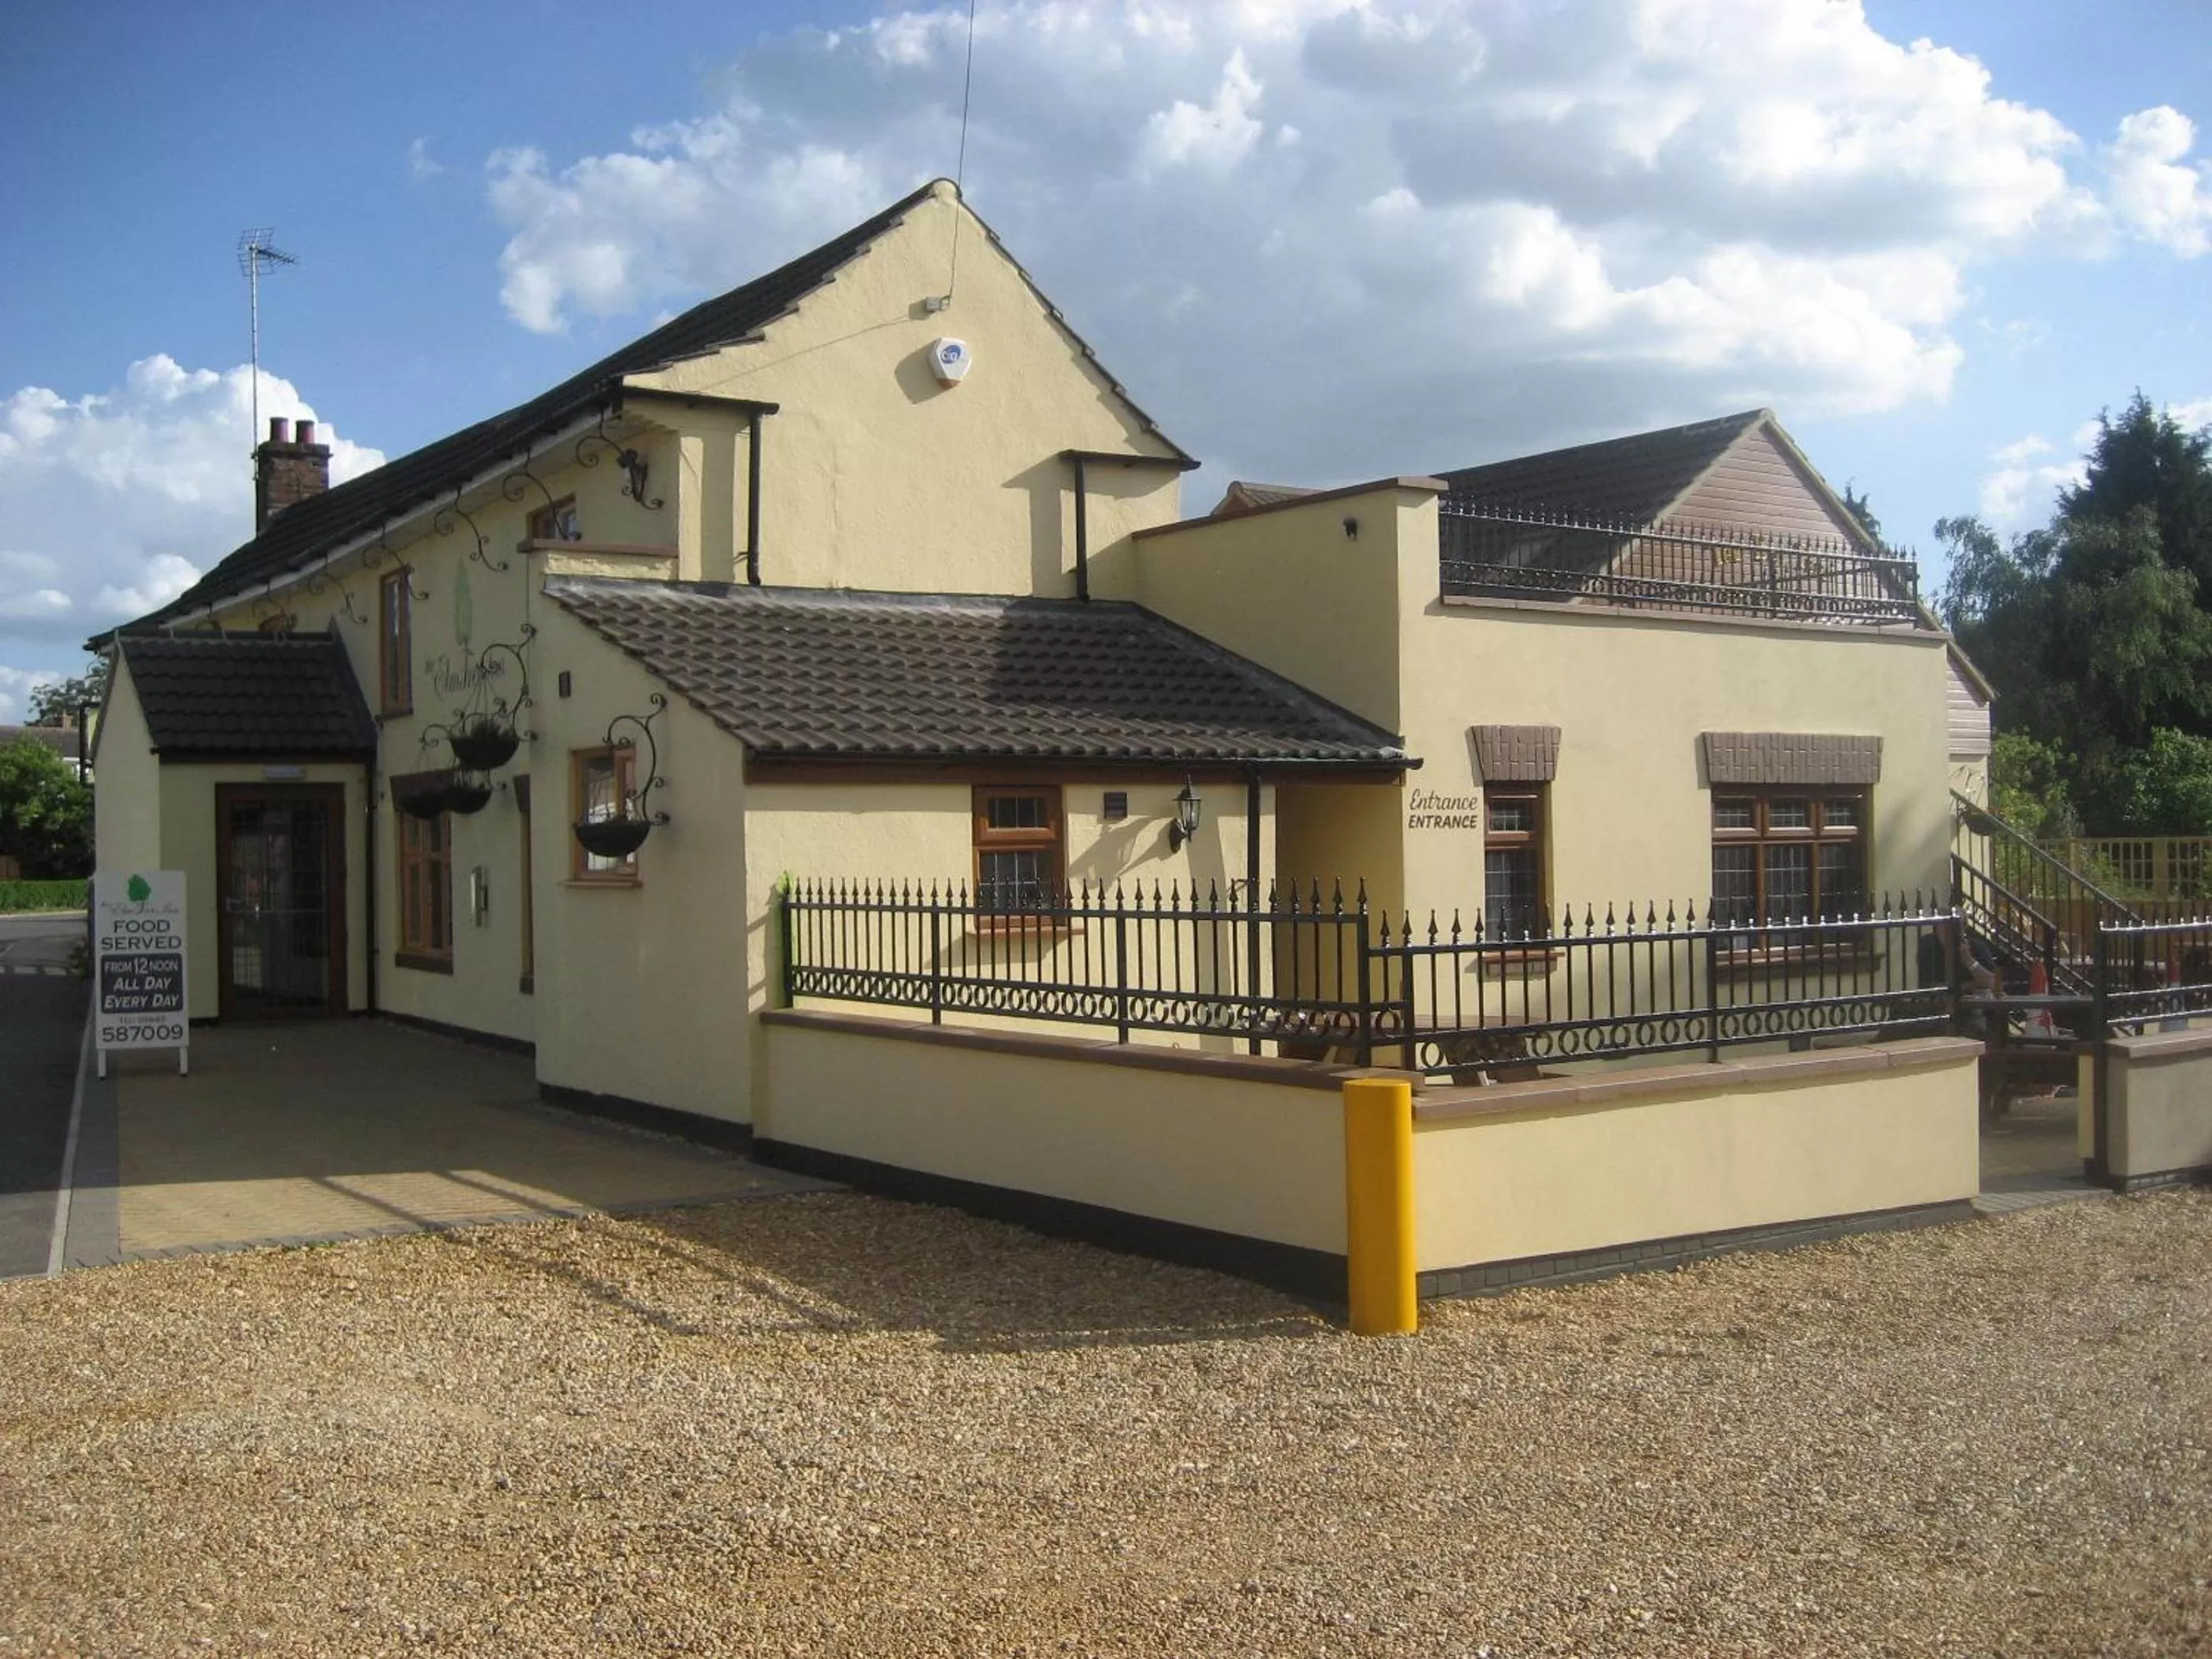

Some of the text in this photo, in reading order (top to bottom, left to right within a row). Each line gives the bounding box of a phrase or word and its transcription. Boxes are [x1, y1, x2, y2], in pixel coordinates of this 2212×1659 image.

[1409, 788, 1478, 811] Entrance
[1408, 815, 1478, 829] ENTRANCE
[114, 920, 170, 933] FOOD
[101, 936, 181, 950] SERVED
[104, 957, 178, 975] FROM 12 NOON
[114, 976, 171, 991] ALL DAY
[104, 994, 179, 1009] EVERY DAY
[103, 1025, 183, 1042] 587009
